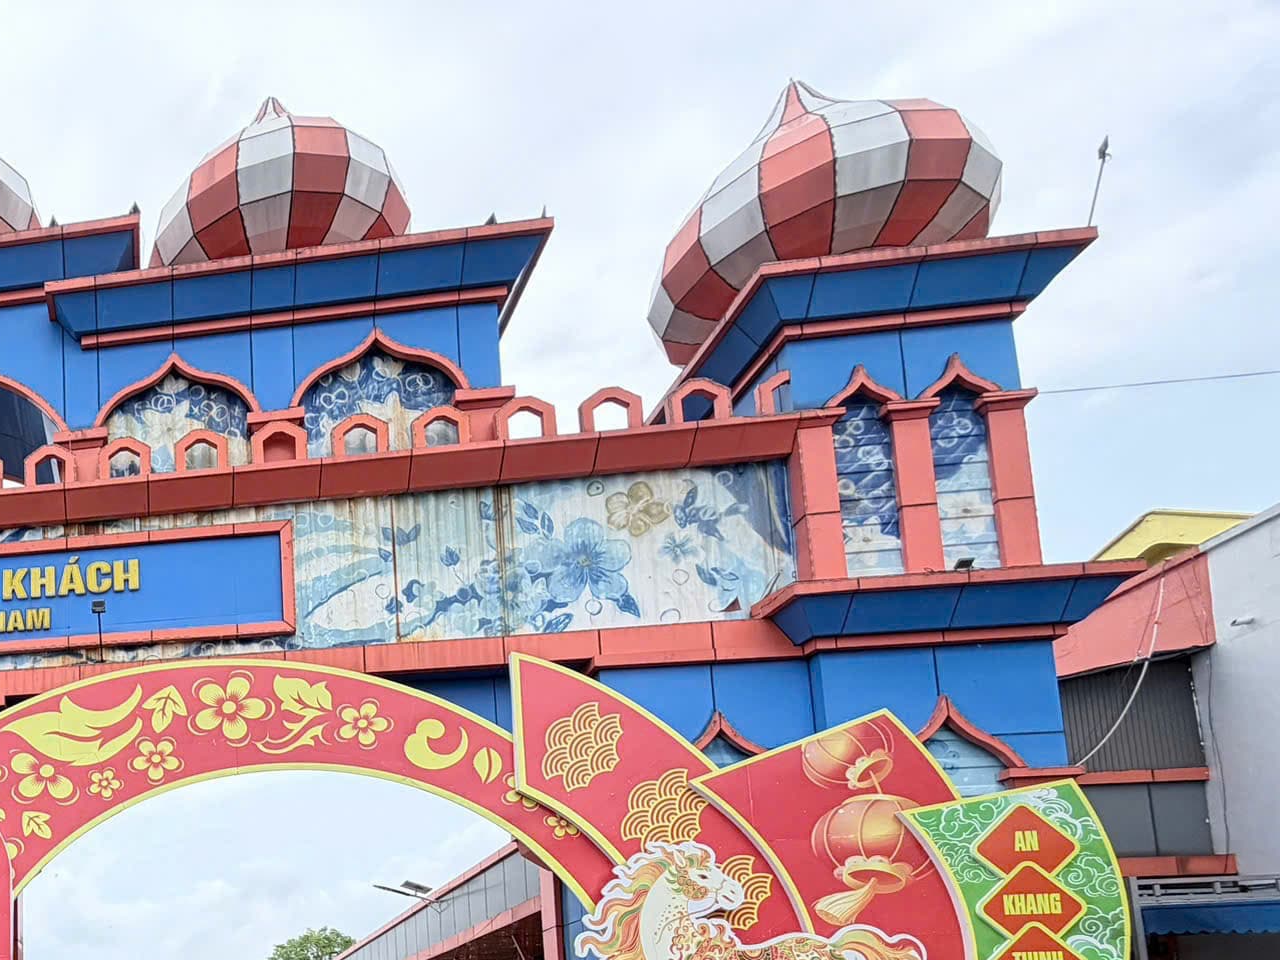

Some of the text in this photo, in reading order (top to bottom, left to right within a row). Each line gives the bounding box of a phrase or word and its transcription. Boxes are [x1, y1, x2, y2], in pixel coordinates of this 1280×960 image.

[2, 556, 141, 601] KHÁCH
[1014, 830, 1040, 852] AN
[1003, 893, 1063, 915] KHANG
